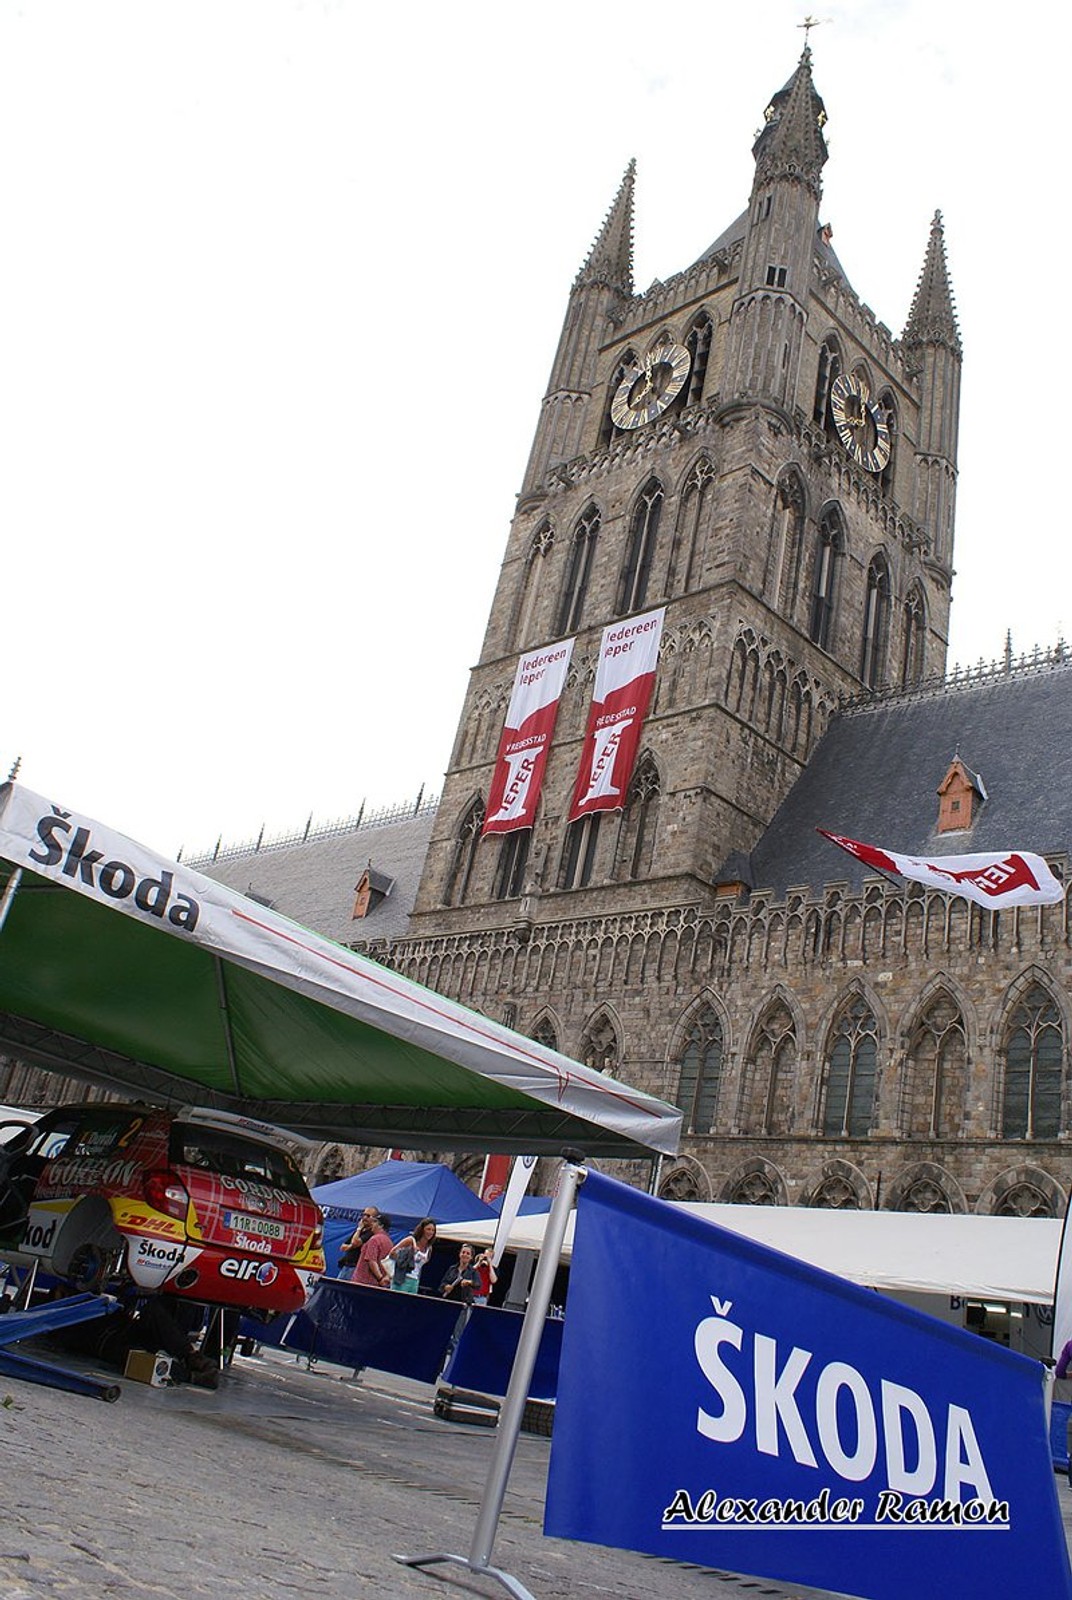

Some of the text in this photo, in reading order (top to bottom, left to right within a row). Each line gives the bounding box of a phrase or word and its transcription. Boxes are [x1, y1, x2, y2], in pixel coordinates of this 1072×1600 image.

[607, 618, 658, 643] Iedereen
[521, 648, 567, 672] Iedereen
[519, 668, 546, 686] Ieper
[596, 706, 638, 727] REDESSTAD
[588, 731, 622, 789] IEPER
[501, 757, 535, 812] IEPER
[28, 804, 202, 933] Škoda
[117, 1116, 144, 1148] 2
[221, 1175, 298, 1206] GORDON
[127, 1214, 176, 1235] DHL
[233, 1215, 280, 1237] 11R 0088
[138, 1239, 185, 1263] Škoda
[234, 1232, 272, 1254] Škoda
[220, 1258, 259, 1281] elf
[694, 1294, 995, 1505] ŠKODA
